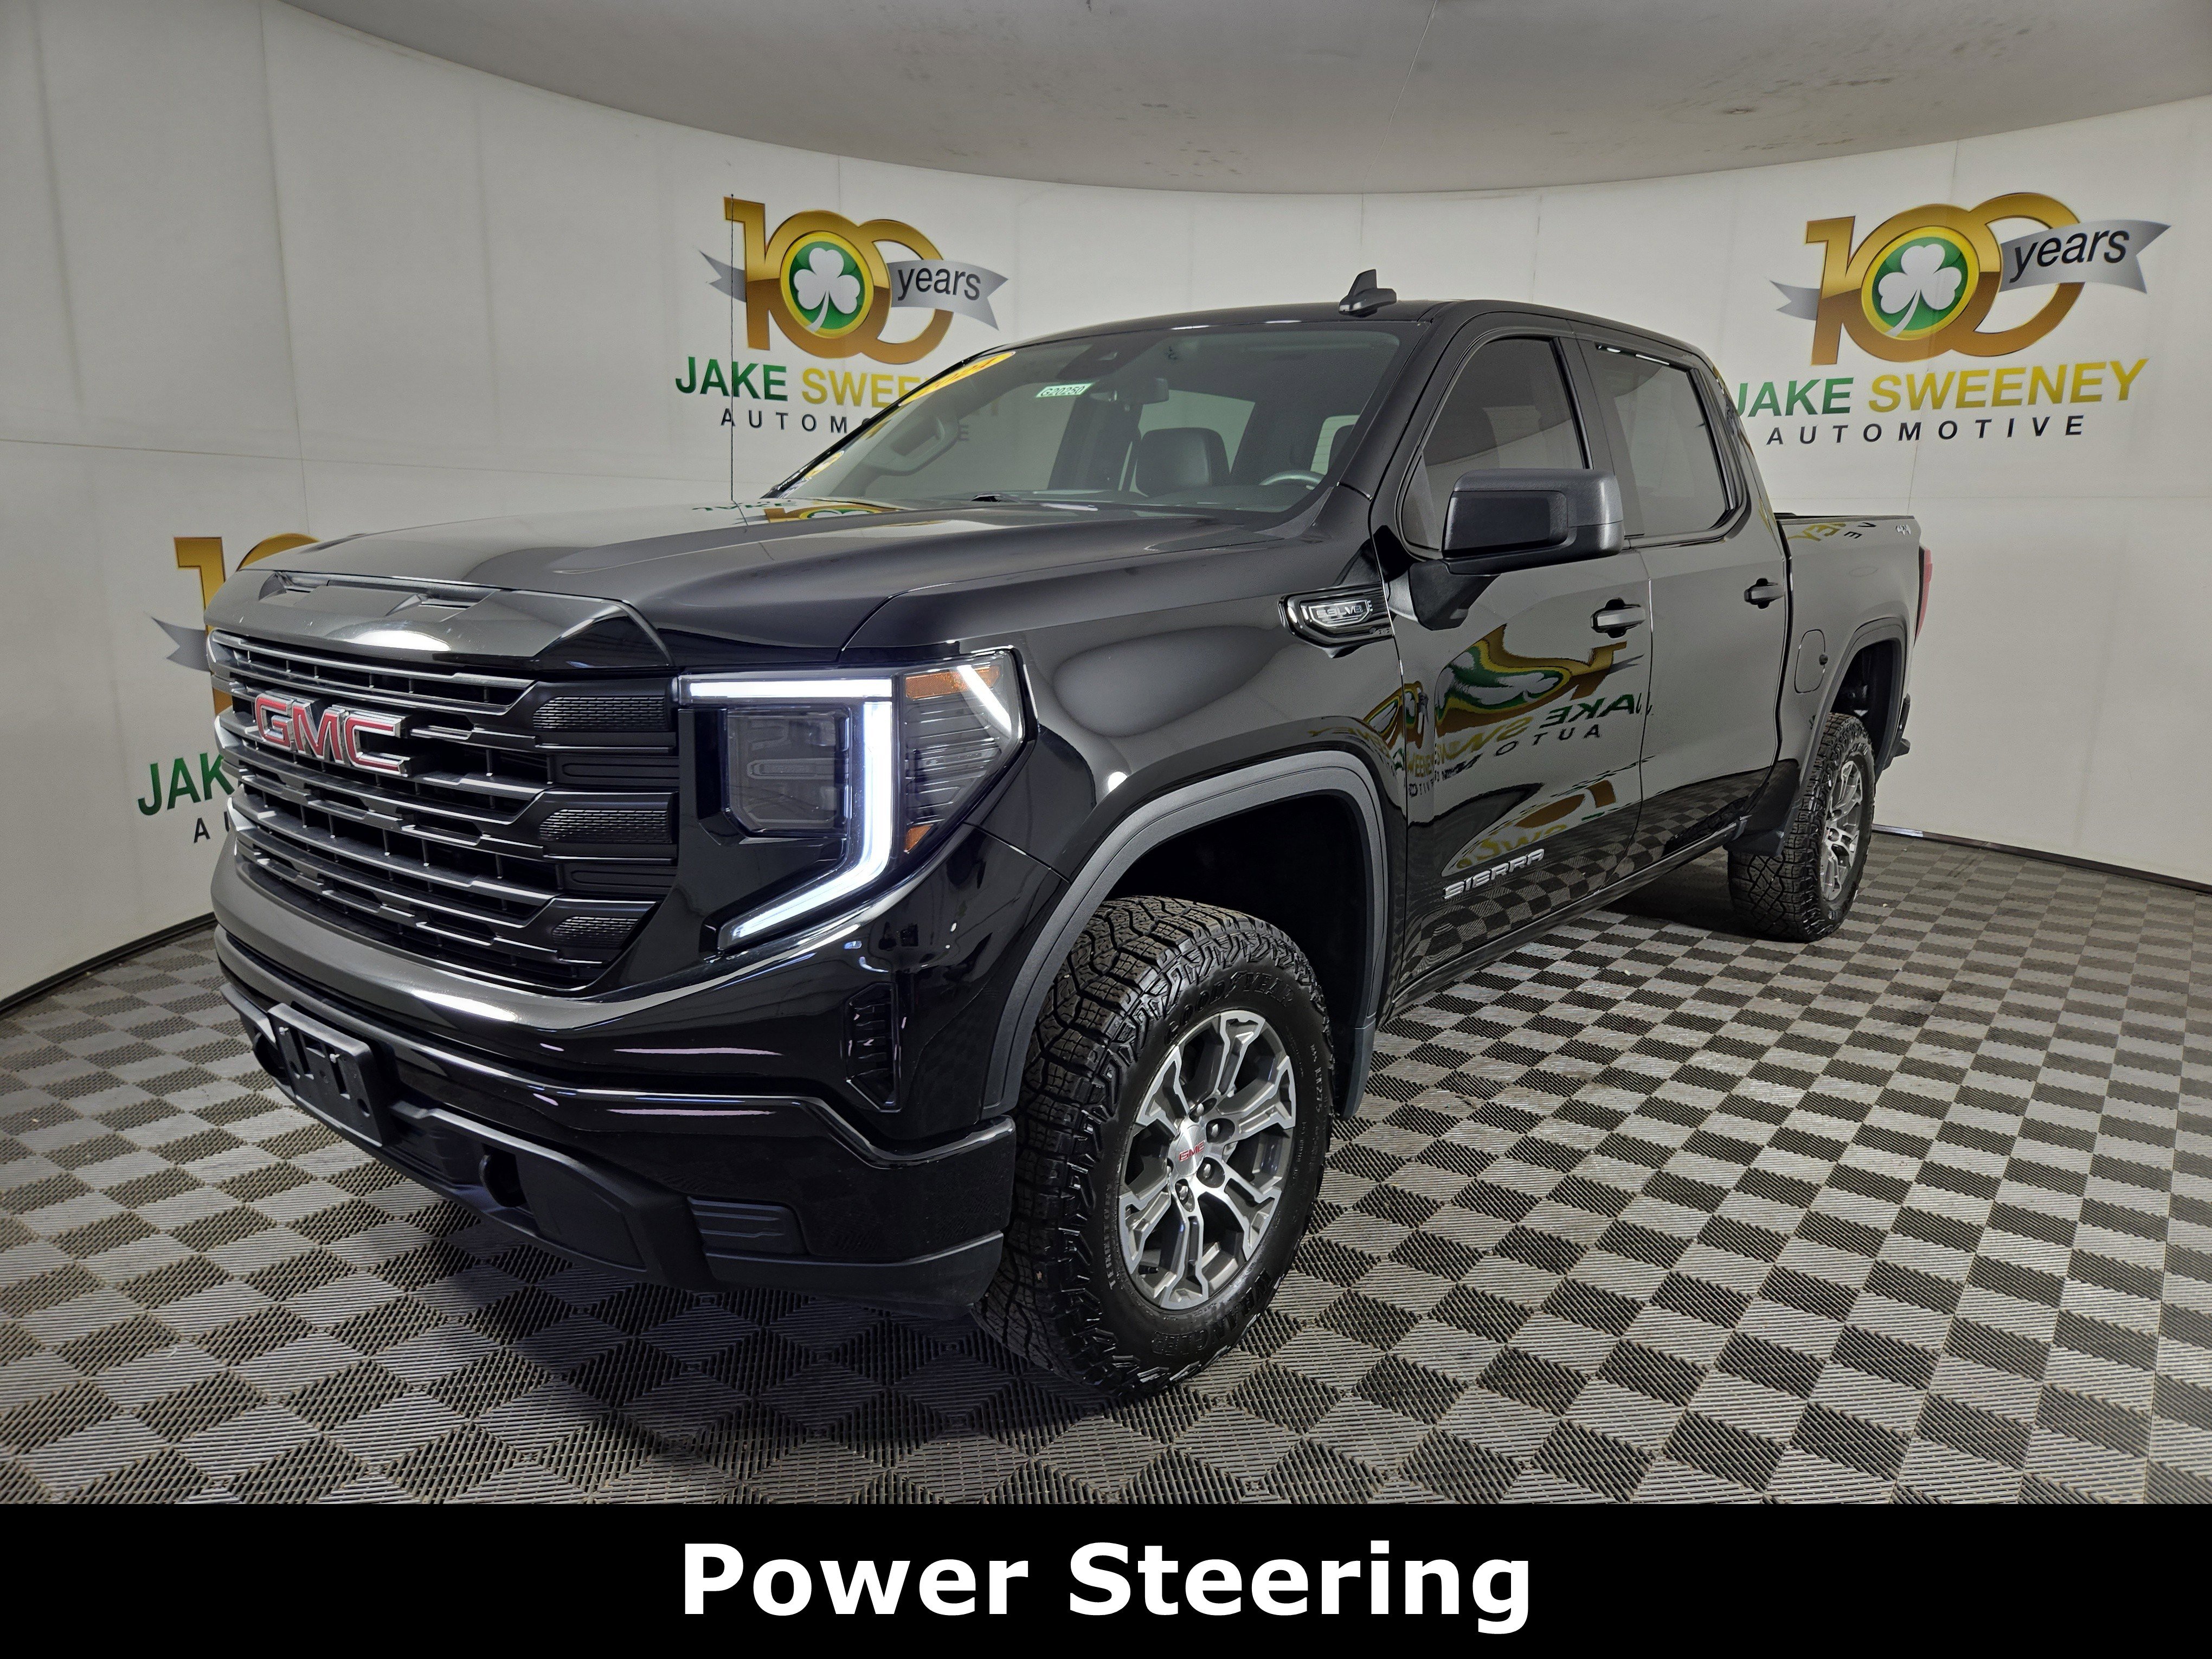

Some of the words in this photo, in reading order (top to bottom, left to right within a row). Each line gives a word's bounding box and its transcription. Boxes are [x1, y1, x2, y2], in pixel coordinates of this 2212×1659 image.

[724, 197, 954, 364] 100
[897, 267, 981, 301] years
[1804, 191, 2087, 365] 100
[2009, 229, 2130, 283] years
[676, 356, 788, 402] JAKE
[802, 368, 930, 408] SWEE
[1736, 377, 1854, 417] JAKE
[1868, 358, 2149, 413] SWEENEY
[721, 408, 870, 434] AUTOM
[1766, 414, 2085, 446] AUTOMOTIVE
[255, 693, 409, 777] GMC
[138, 752, 235, 816] JAK
[1443, 848, 1545, 900] SIERRA
[1178, 1139, 1206, 1162] GMC
